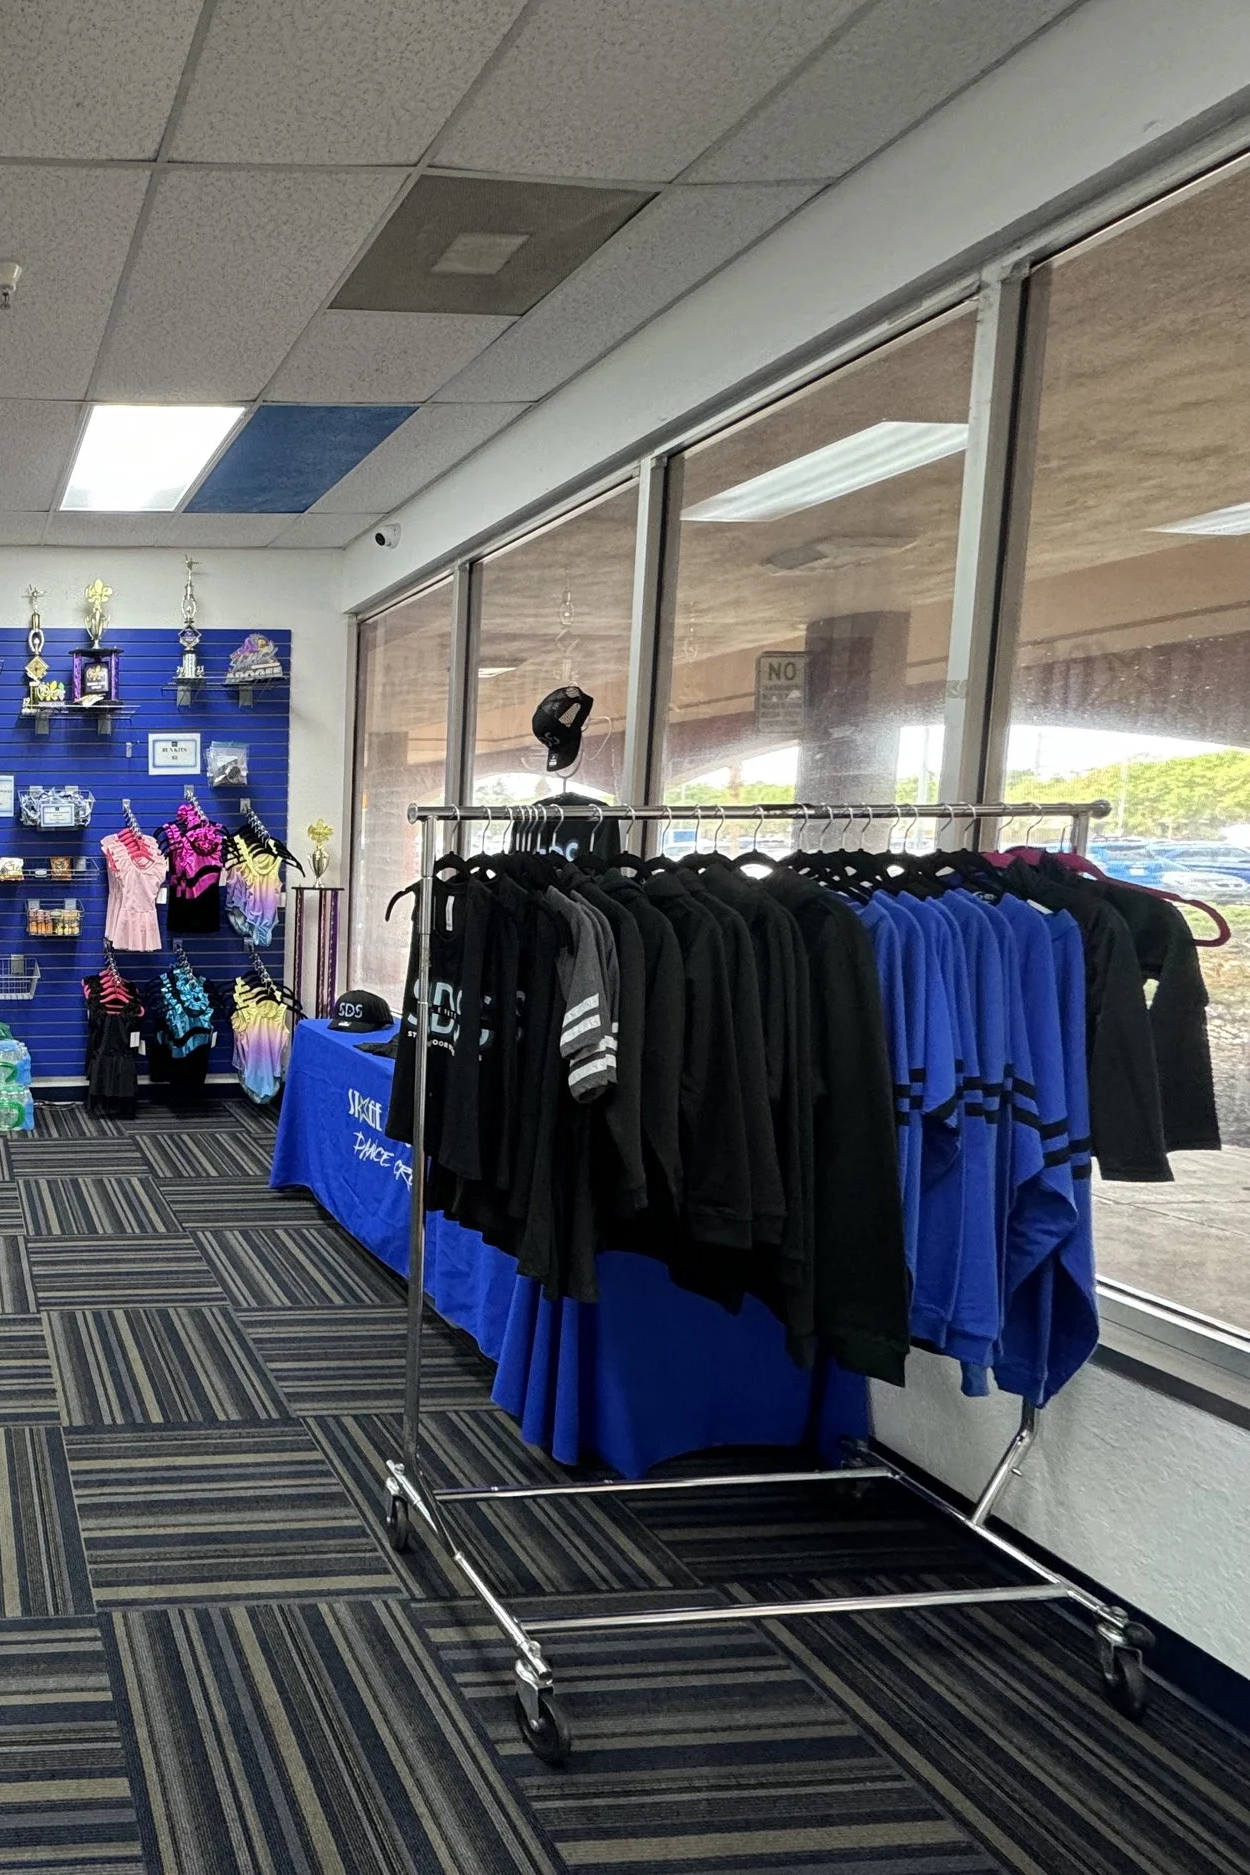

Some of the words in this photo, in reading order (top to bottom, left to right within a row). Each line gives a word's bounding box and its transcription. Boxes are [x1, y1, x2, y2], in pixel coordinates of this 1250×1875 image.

[768, 662, 796, 681] NO
[338, 1002, 363, 1018] SDS
[427, 1038, 449, 1049] OOR
